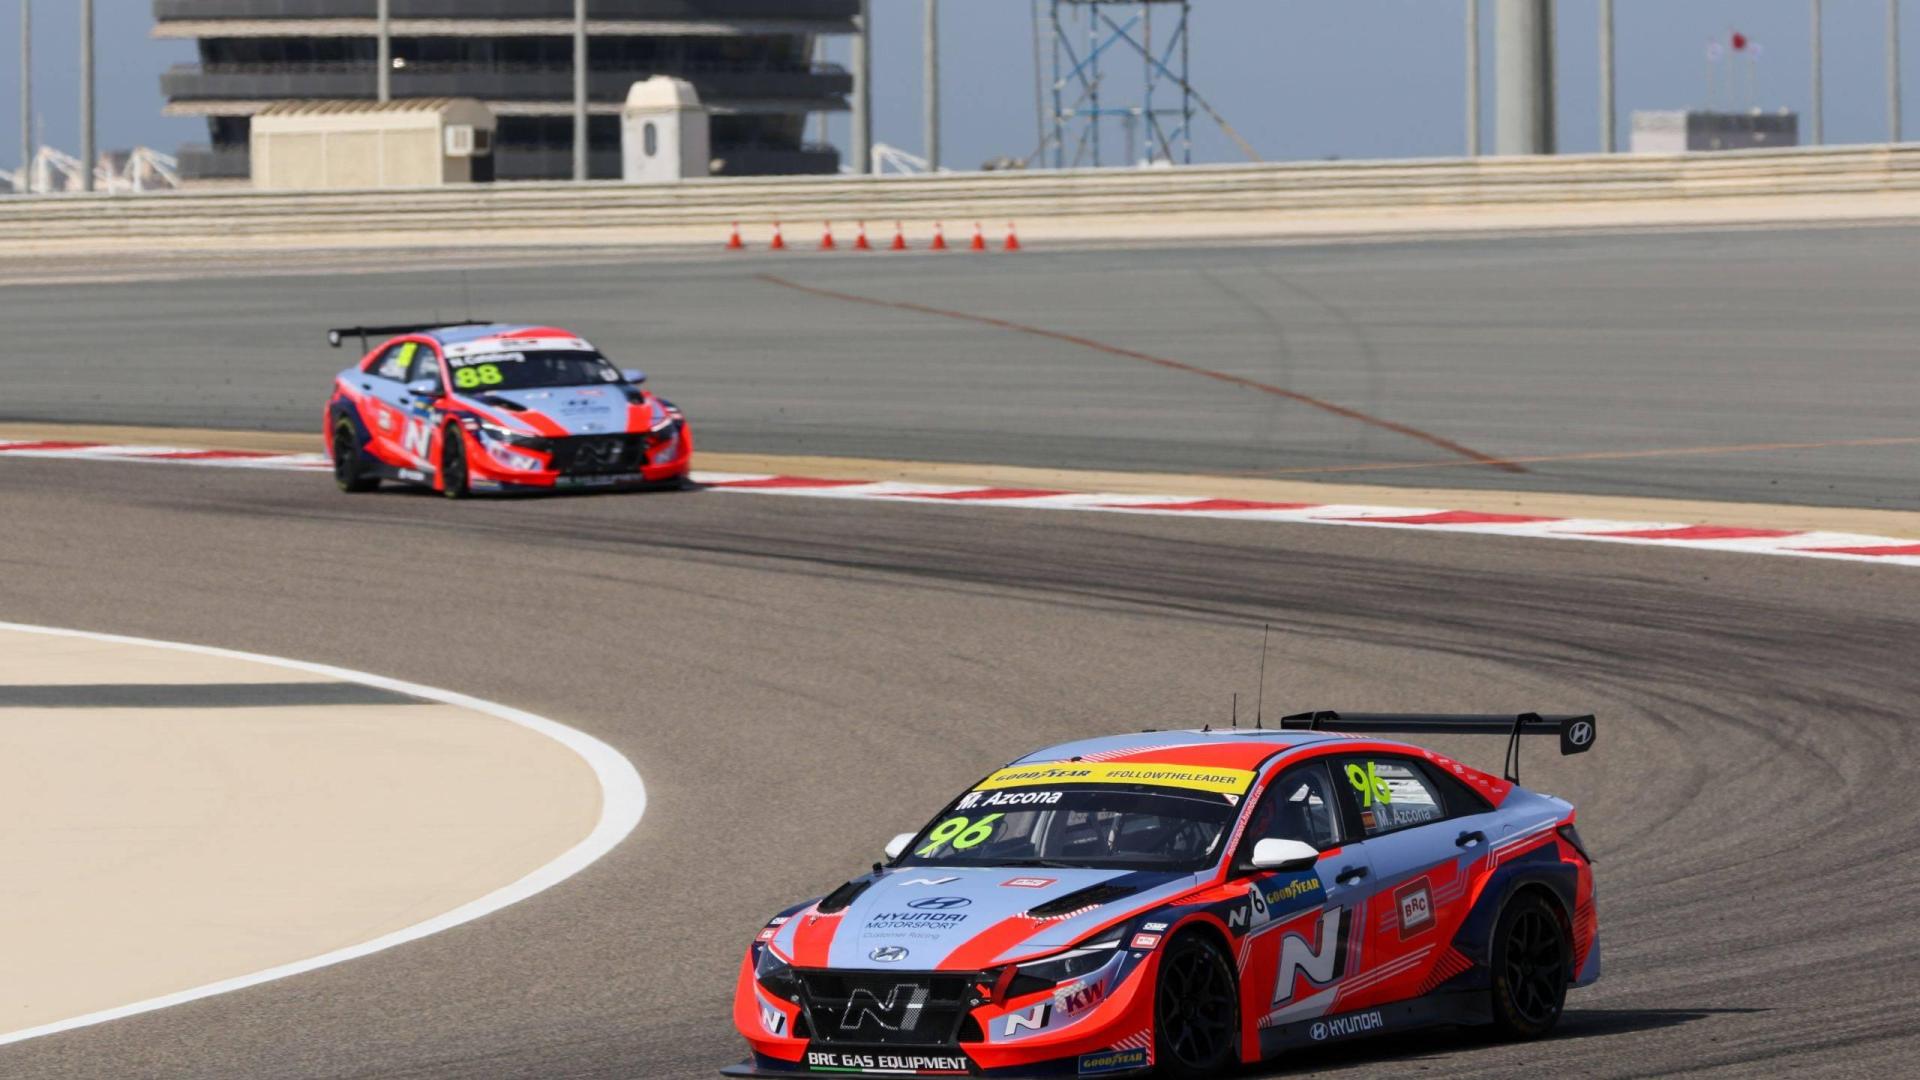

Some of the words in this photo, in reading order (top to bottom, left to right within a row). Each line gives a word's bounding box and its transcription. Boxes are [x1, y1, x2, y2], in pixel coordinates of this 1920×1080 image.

[455, 363, 503, 388] 88
[995, 769, 1091, 782] GOODYEAR
[1105, 770, 1237, 785] #FOLLOWTHELEADER
[1348, 761, 1391, 807] 96
[955, 791, 982, 811] M.
[981, 791, 1063, 807] Azcona
[1377, 810, 1392, 827] M.
[1393, 809, 1431, 825] Azcona
[914, 812, 1006, 856] 96
[1266, 879, 1320, 904] GOODYEAR
[872, 912, 969, 922] HYUNDAI
[1405, 898, 1426, 918] BRC
[864, 921, 959, 930] MOTORSPORT
[908, 932, 941, 940] Racing
[1065, 978, 1104, 1014] KW
[1328, 1011, 1384, 1037] HYUNDAI
[808, 1052, 839, 1066] BRC
[842, 1053, 874, 1068] GAS
[878, 1055, 968, 1070] EQUIPMENT
[1083, 1052, 1143, 1068] GOODYEAR
